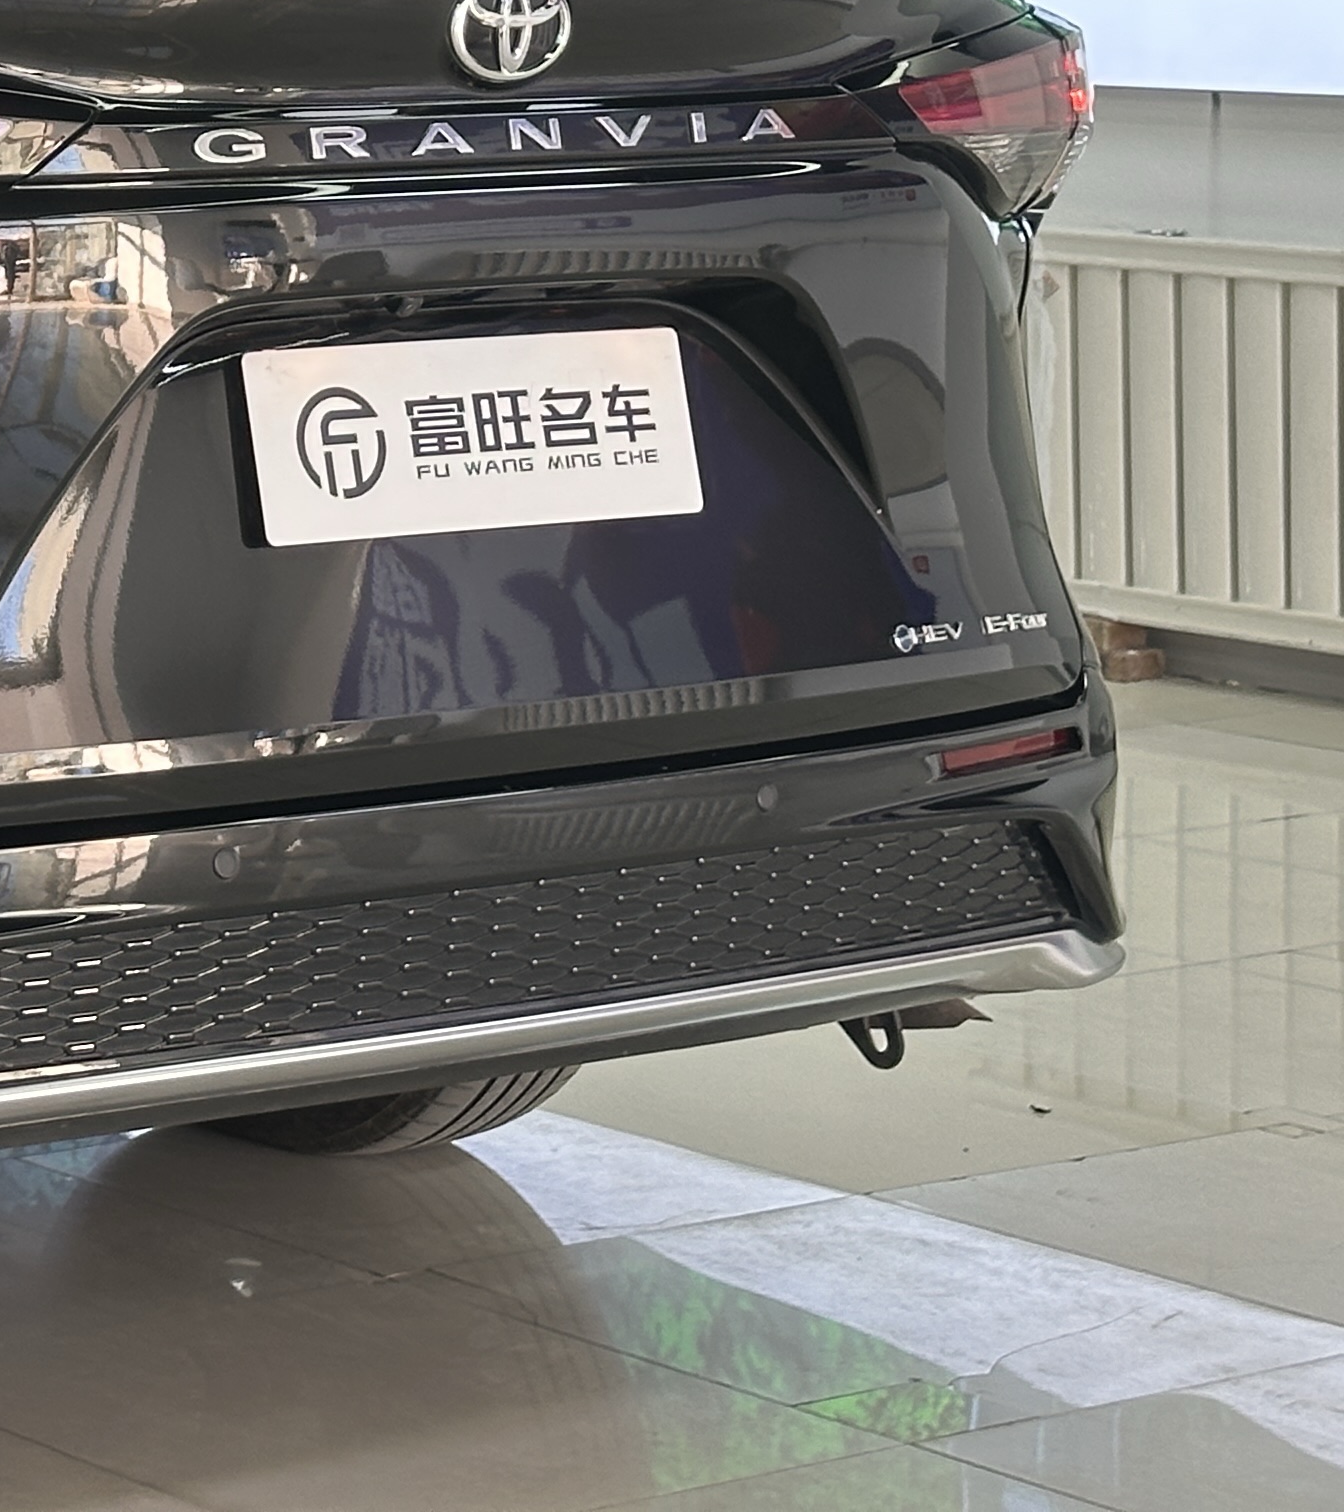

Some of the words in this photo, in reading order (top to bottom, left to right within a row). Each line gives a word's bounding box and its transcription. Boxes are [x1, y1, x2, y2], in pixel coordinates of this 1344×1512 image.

[194, 108, 794, 164] GRANVIA
[403, 384, 656, 457] 富旺名车
[416, 464, 450, 479] FU
[464, 457, 534, 476] WANG
[548, 452, 602, 470] MING
[613, 448, 659, 466] CHE
[912, 621, 964, 645] HEV
